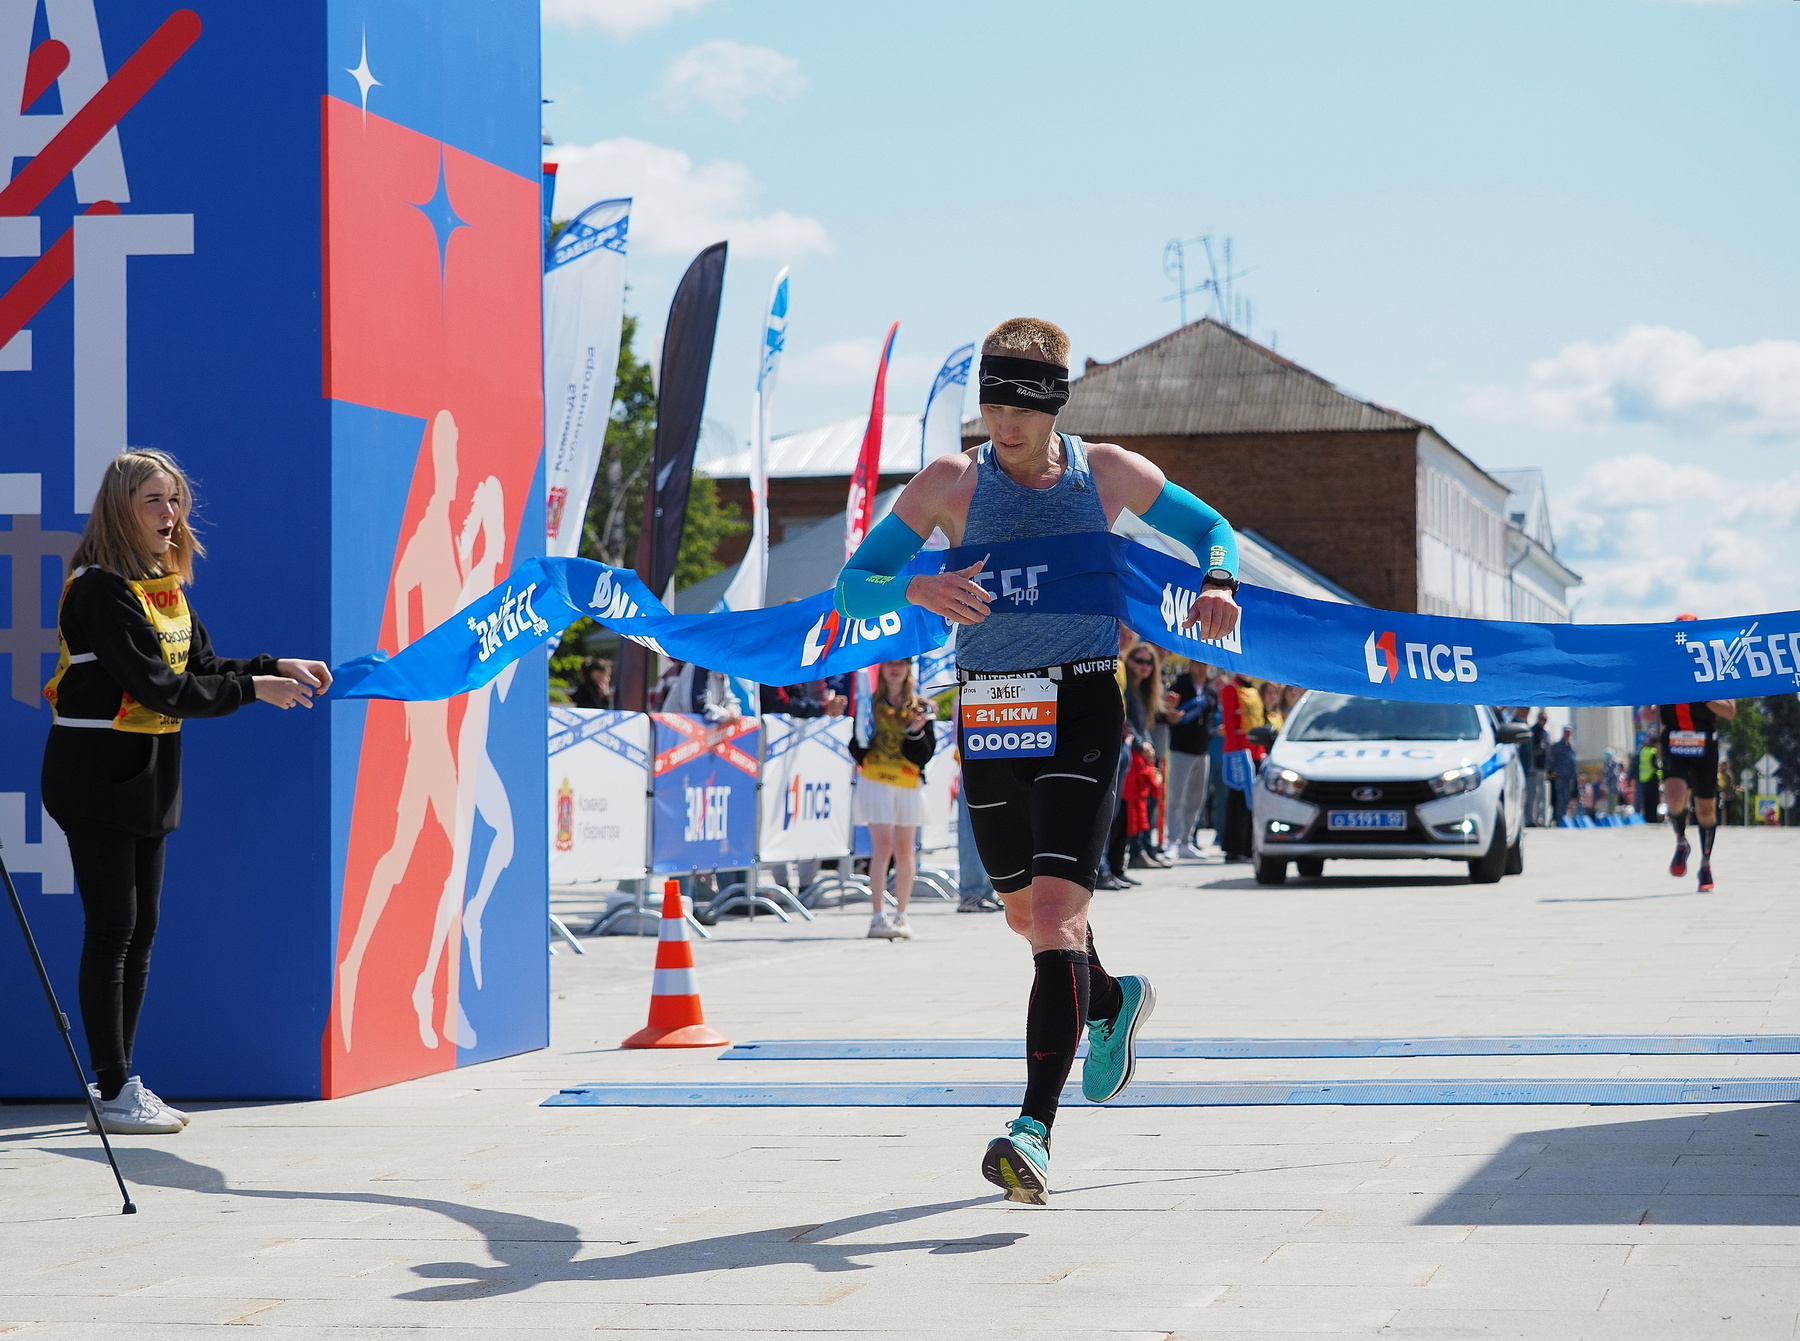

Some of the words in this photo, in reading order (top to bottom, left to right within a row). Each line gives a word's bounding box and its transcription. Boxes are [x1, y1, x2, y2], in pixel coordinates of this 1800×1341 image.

[1405, 642, 1478, 683] ПСБ
[967, 731, 1053, 752] 00029
[1306, 749, 1434, 763] ДПС
[804, 783, 831, 819] ПСБ
